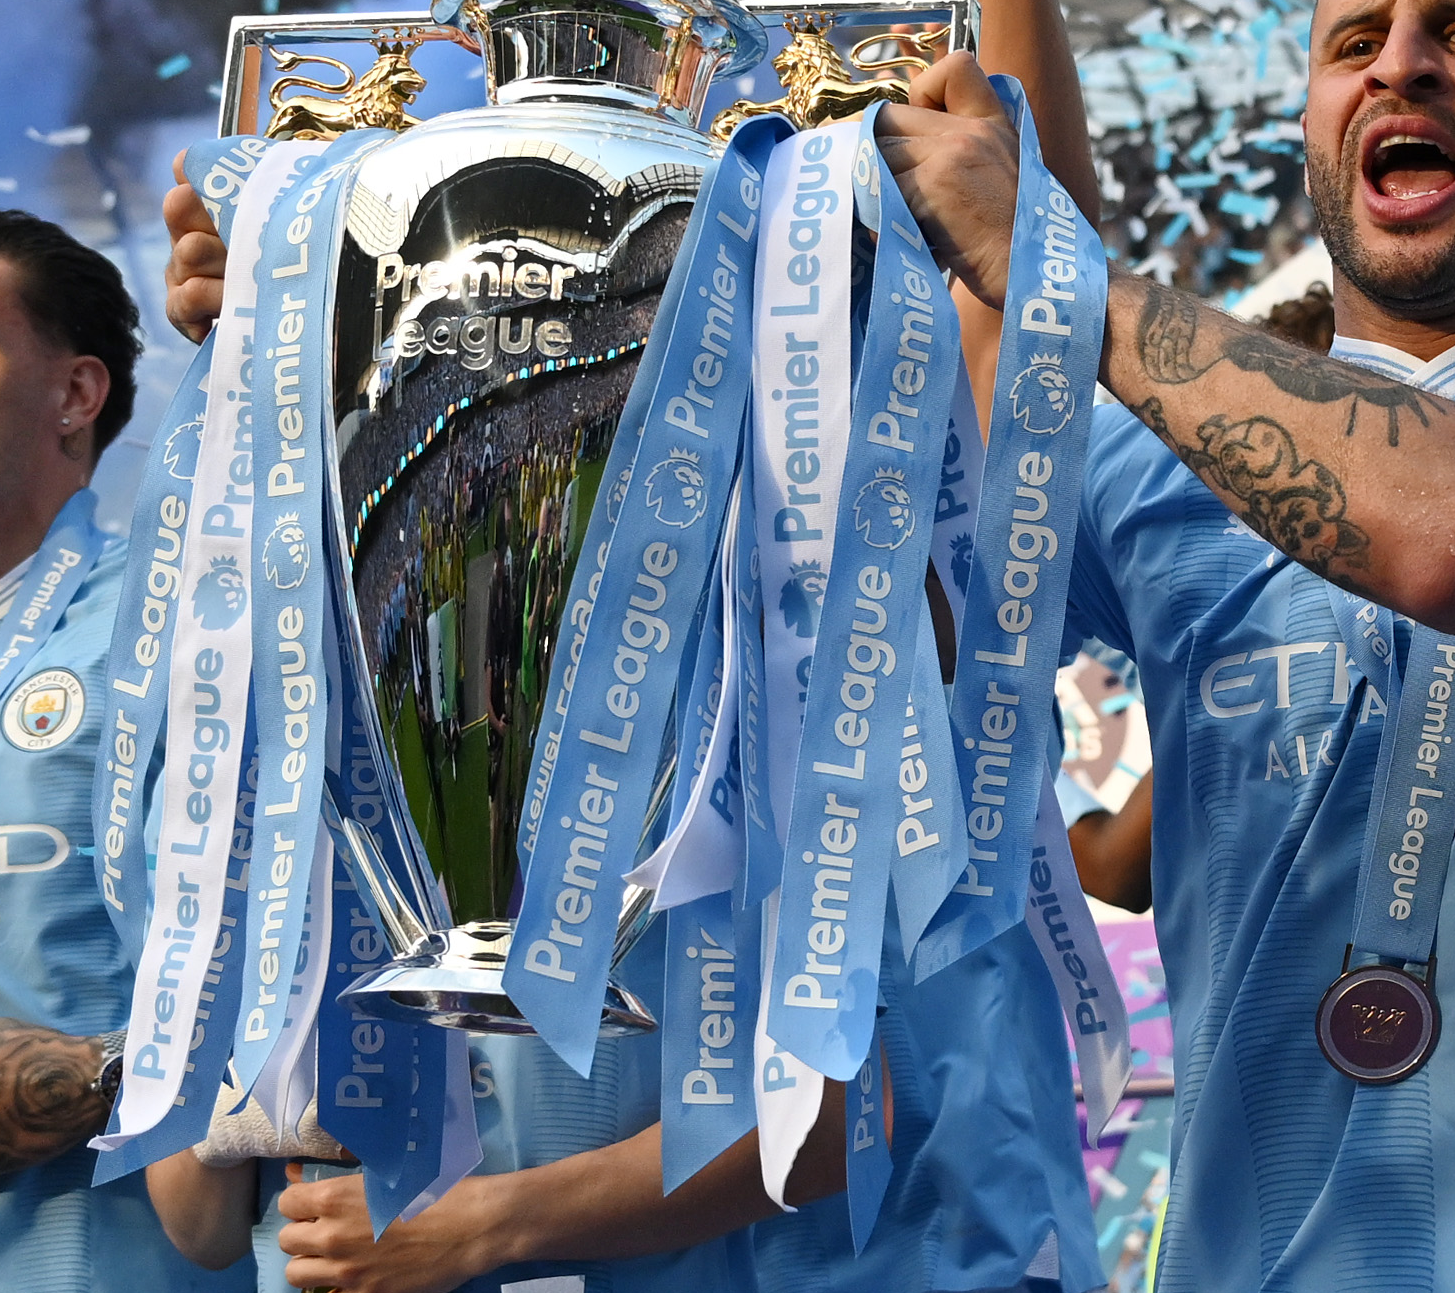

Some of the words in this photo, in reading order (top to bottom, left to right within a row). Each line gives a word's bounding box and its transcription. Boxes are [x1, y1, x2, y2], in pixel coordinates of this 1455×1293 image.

[376, 246, 576, 310] Premier
[770, 134, 840, 317] League
[1020, 175, 1078, 338] Premier
[266, 293, 309, 497] Premier
[373, 315, 574, 370] League
[664, 244, 740, 439] Premier
[772, 331, 822, 543] Premier
[866, 253, 935, 454] Premier
[19, 547, 82, 631] Premier
[113, 495, 187, 698] League
[975, 451, 1061, 668] League
[14, 674, 80, 706] MANCHESTER
[27, 737, 53, 748] CITY
[265, 606, 318, 817] League
[524, 763, 620, 983] Premier
[580, 542, 679, 754] League
[813, 565, 897, 781] League
[101, 710, 137, 912] Premier
[132, 871, 201, 1082] Premier
[169, 647, 232, 856] League
[950, 681, 1022, 898] Premier
[1388, 785, 1437, 922] League
[244, 832, 296, 1043] Premier
[784, 792, 861, 1011] Premier
[1032, 845, 1109, 1037] Premier
